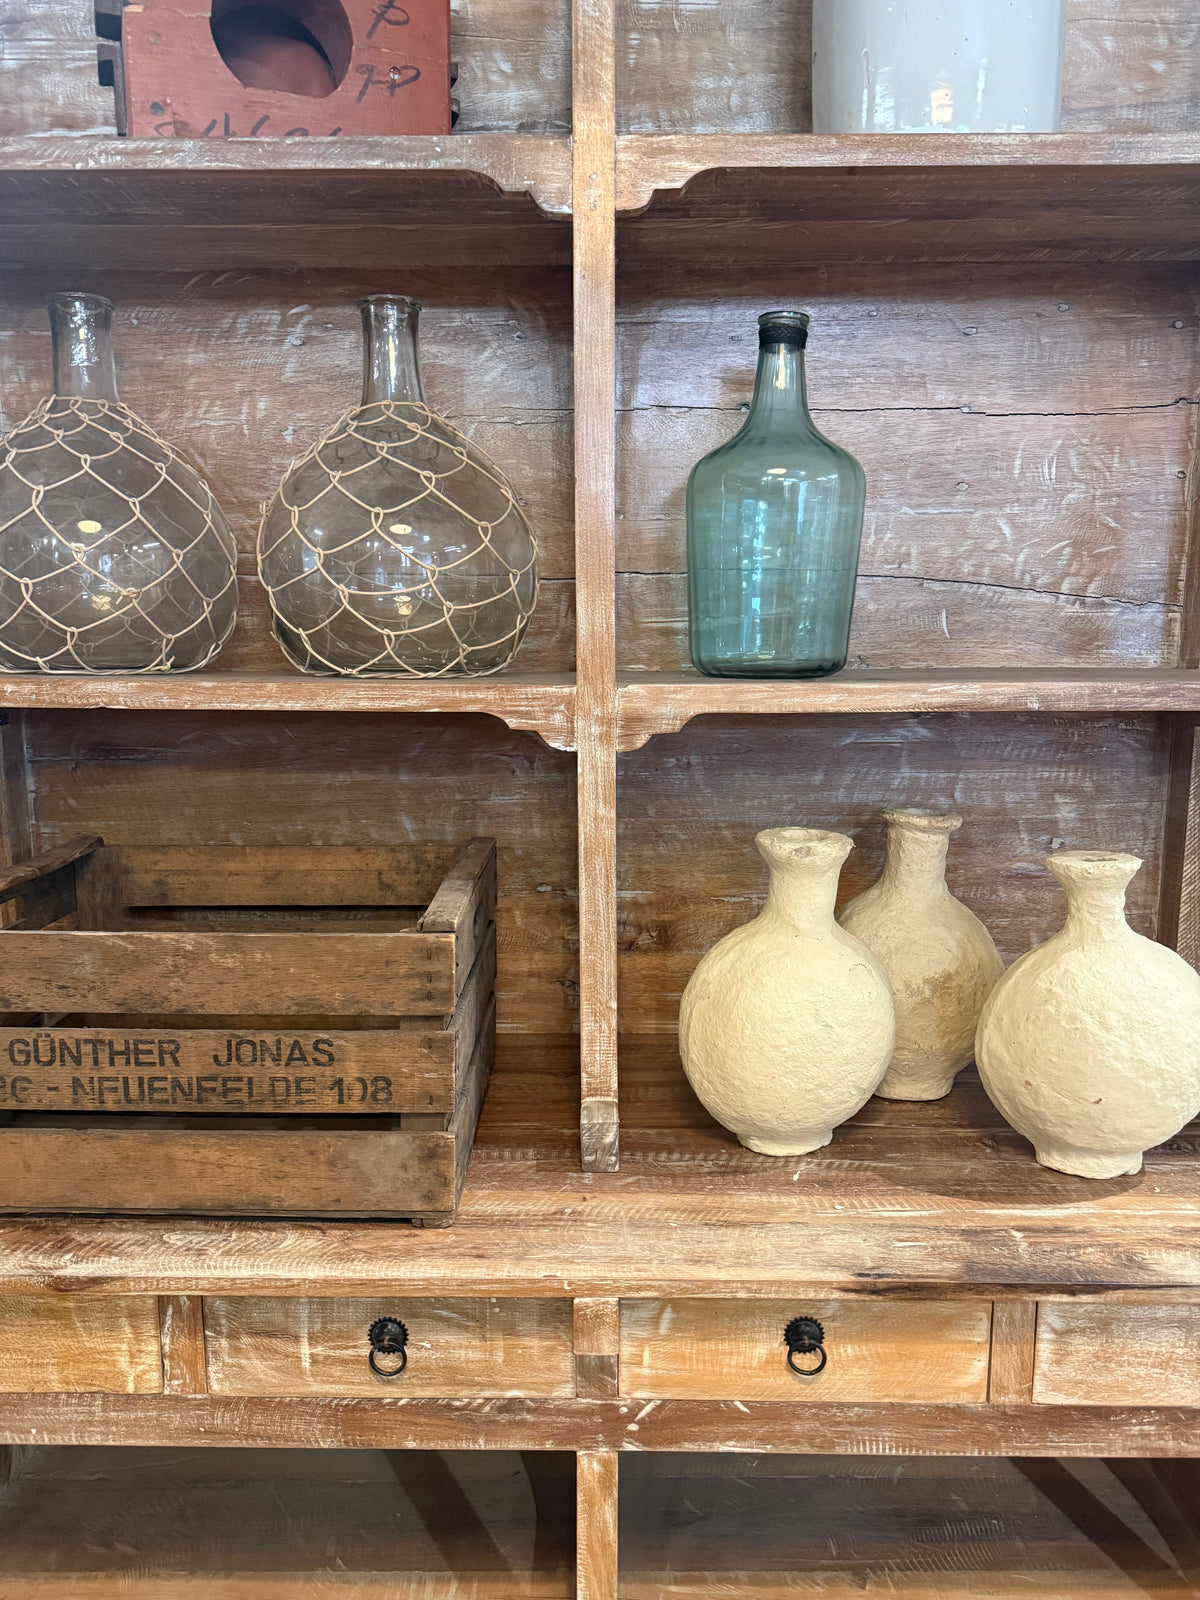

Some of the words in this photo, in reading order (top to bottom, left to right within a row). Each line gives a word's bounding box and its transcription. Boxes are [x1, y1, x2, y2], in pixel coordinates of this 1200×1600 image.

[8, 1033, 182, 1068] GÜNTHER
[212, 1037, 336, 1068] JONAS
[328, 1075, 395, 1105] 108
